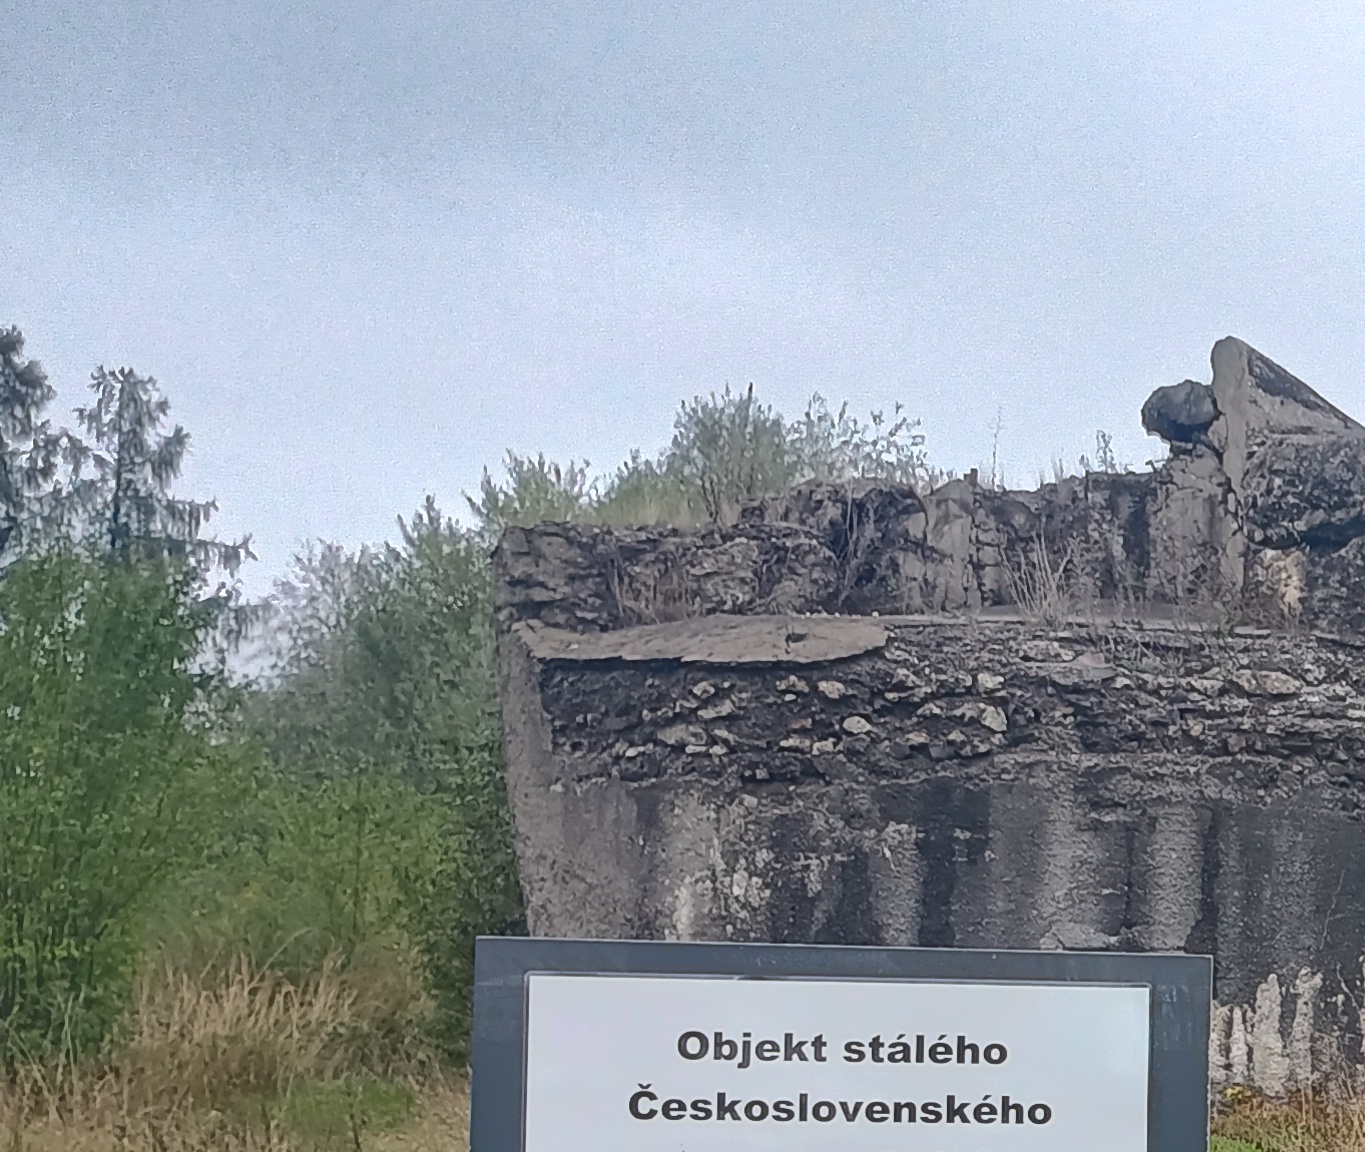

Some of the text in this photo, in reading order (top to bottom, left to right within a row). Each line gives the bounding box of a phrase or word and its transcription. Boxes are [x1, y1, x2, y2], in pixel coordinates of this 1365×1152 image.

[678, 1031, 1008, 1068] Objekt stálého
[629, 1084, 1052, 1125] Československého
